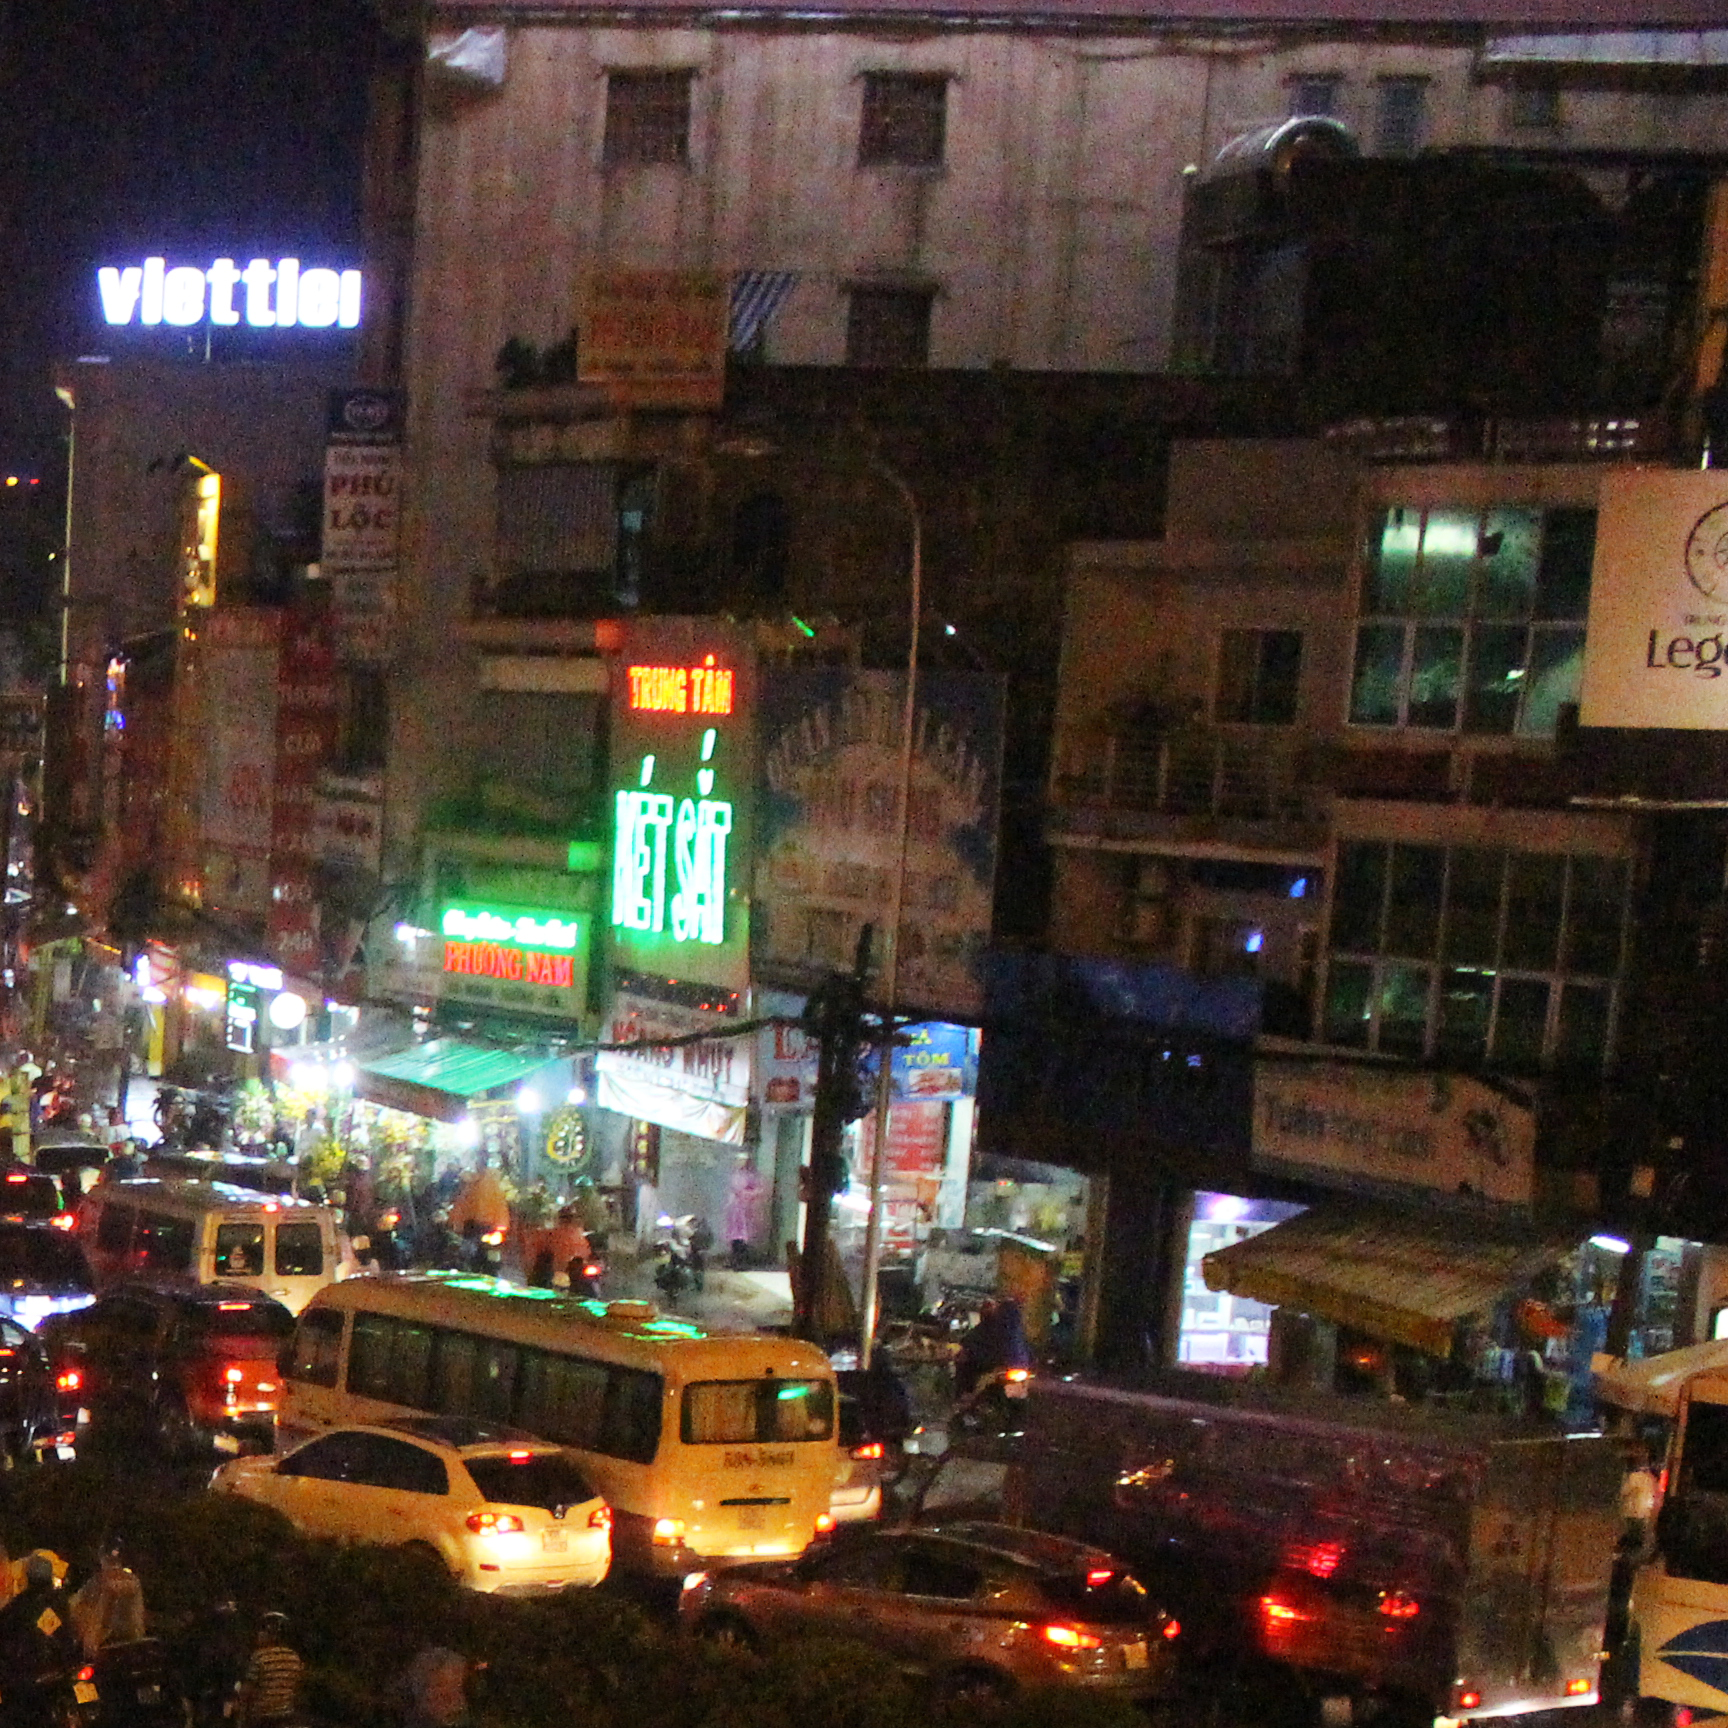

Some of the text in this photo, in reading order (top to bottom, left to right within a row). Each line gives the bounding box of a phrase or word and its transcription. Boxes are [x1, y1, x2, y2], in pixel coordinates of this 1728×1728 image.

[1647, 629, 1728, 680] Leg
[629, 655, 735, 715] TRUNG TÂM
[525, 951, 575, 987] NAM
